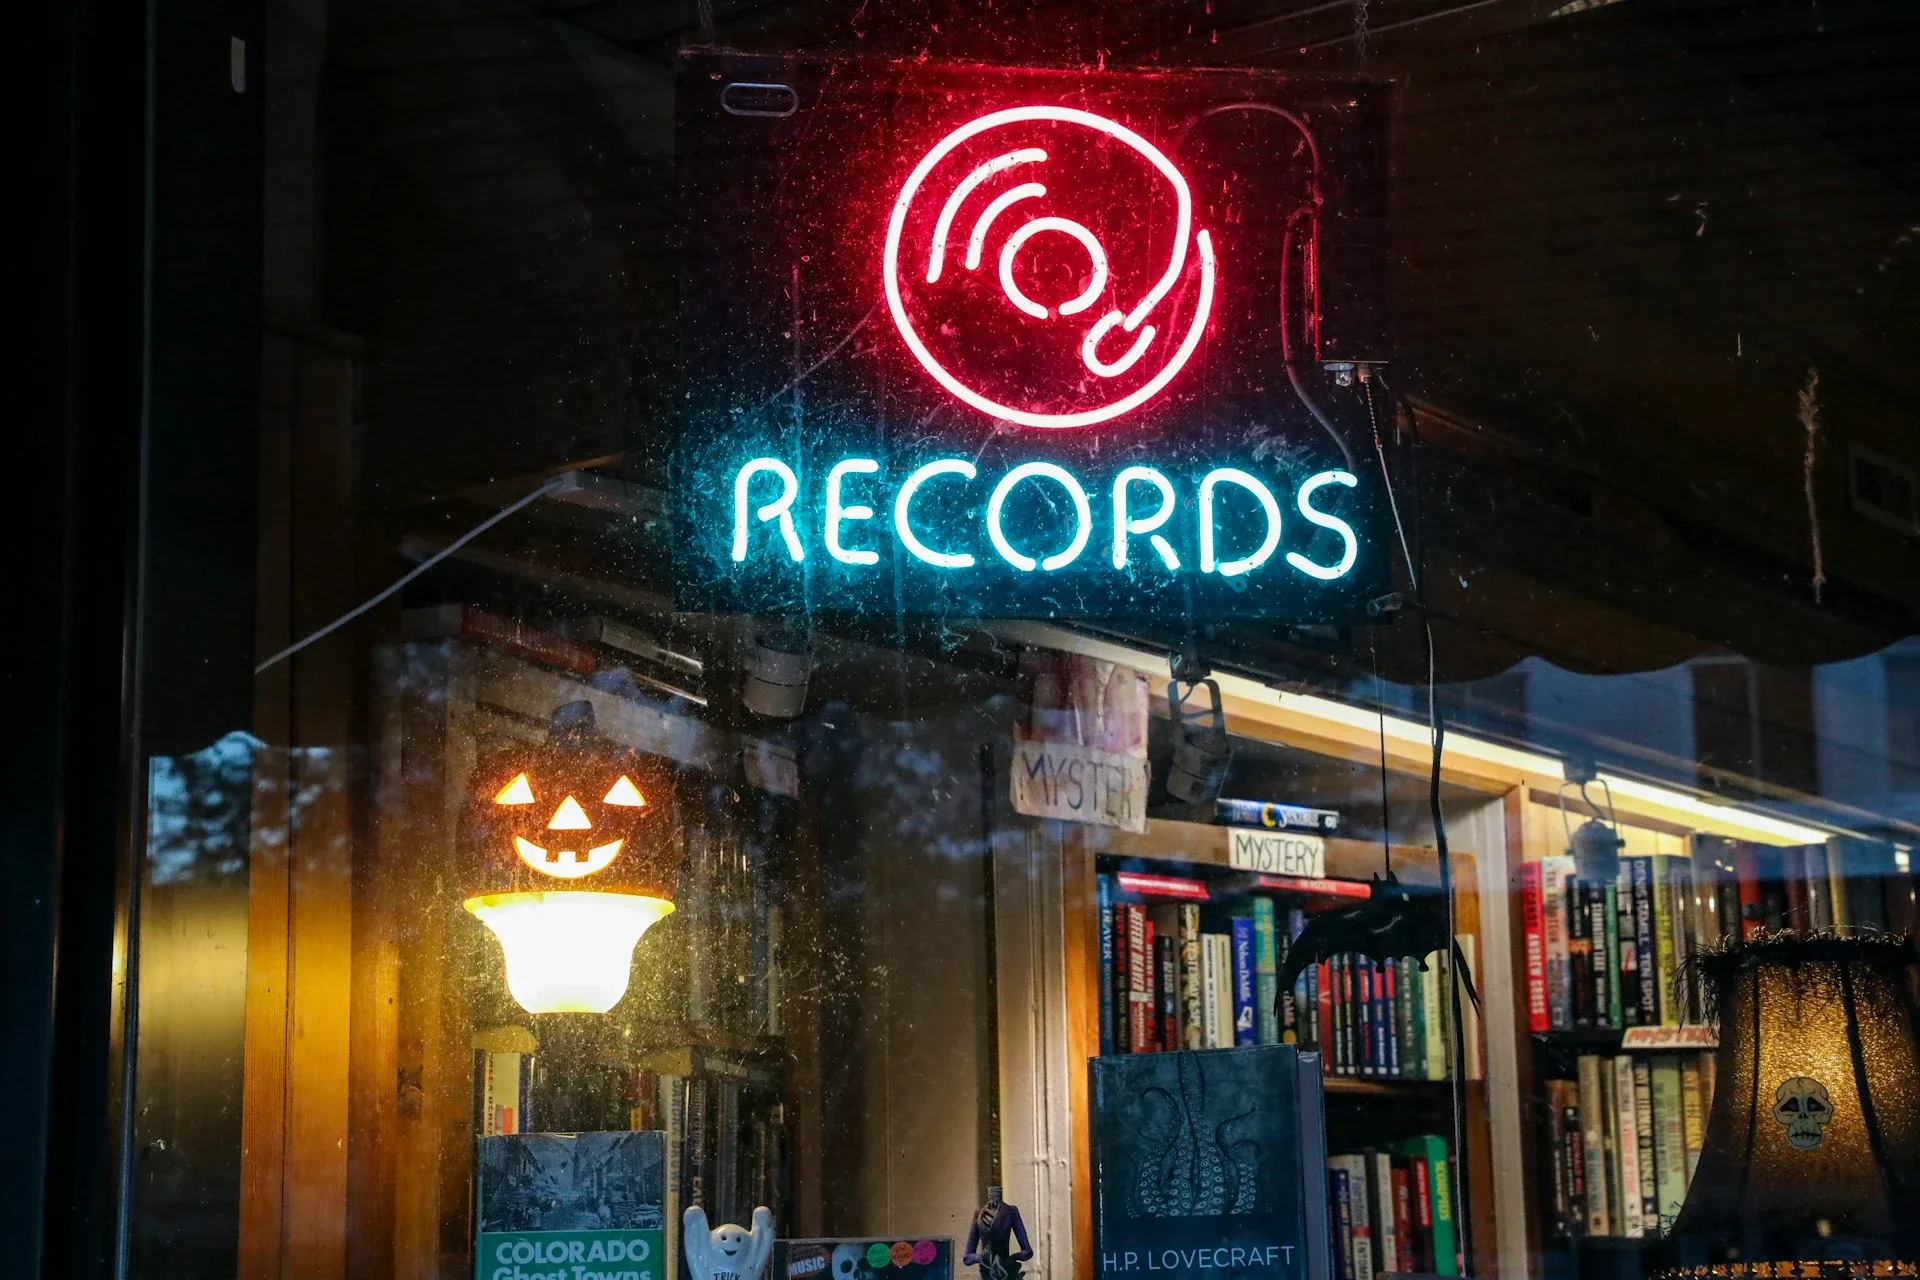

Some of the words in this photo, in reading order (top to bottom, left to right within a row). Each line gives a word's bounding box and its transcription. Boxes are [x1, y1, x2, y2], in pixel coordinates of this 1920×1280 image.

[731, 457, 1359, 580] RECORDS
[1235, 833, 1319, 878] MYSTERY
[1634, 859, 1648, 898] DENIS
[1102, 909, 1112, 960] DEAVER
[1130, 907, 1144, 952] JEFFERY
[1130, 951, 1144, 992] DEAVER
[1527, 933, 1543, 976] ANDREW
[1639, 951, 1653, 978] TEN
[1529, 979, 1546, 1015] GROSS
[1641, 979, 1655, 1013] SPOT
[495, 1239, 650, 1264] COLORADO
[788, 1255, 826, 1276] MUSIC
[1102, 1252, 1140, 1272] H.P.
[1148, 1245, 1295, 1270] LOVECRAFT
[492, 1264, 568, 1280] Ghost
[572, 1265, 652, 1280] Towns
